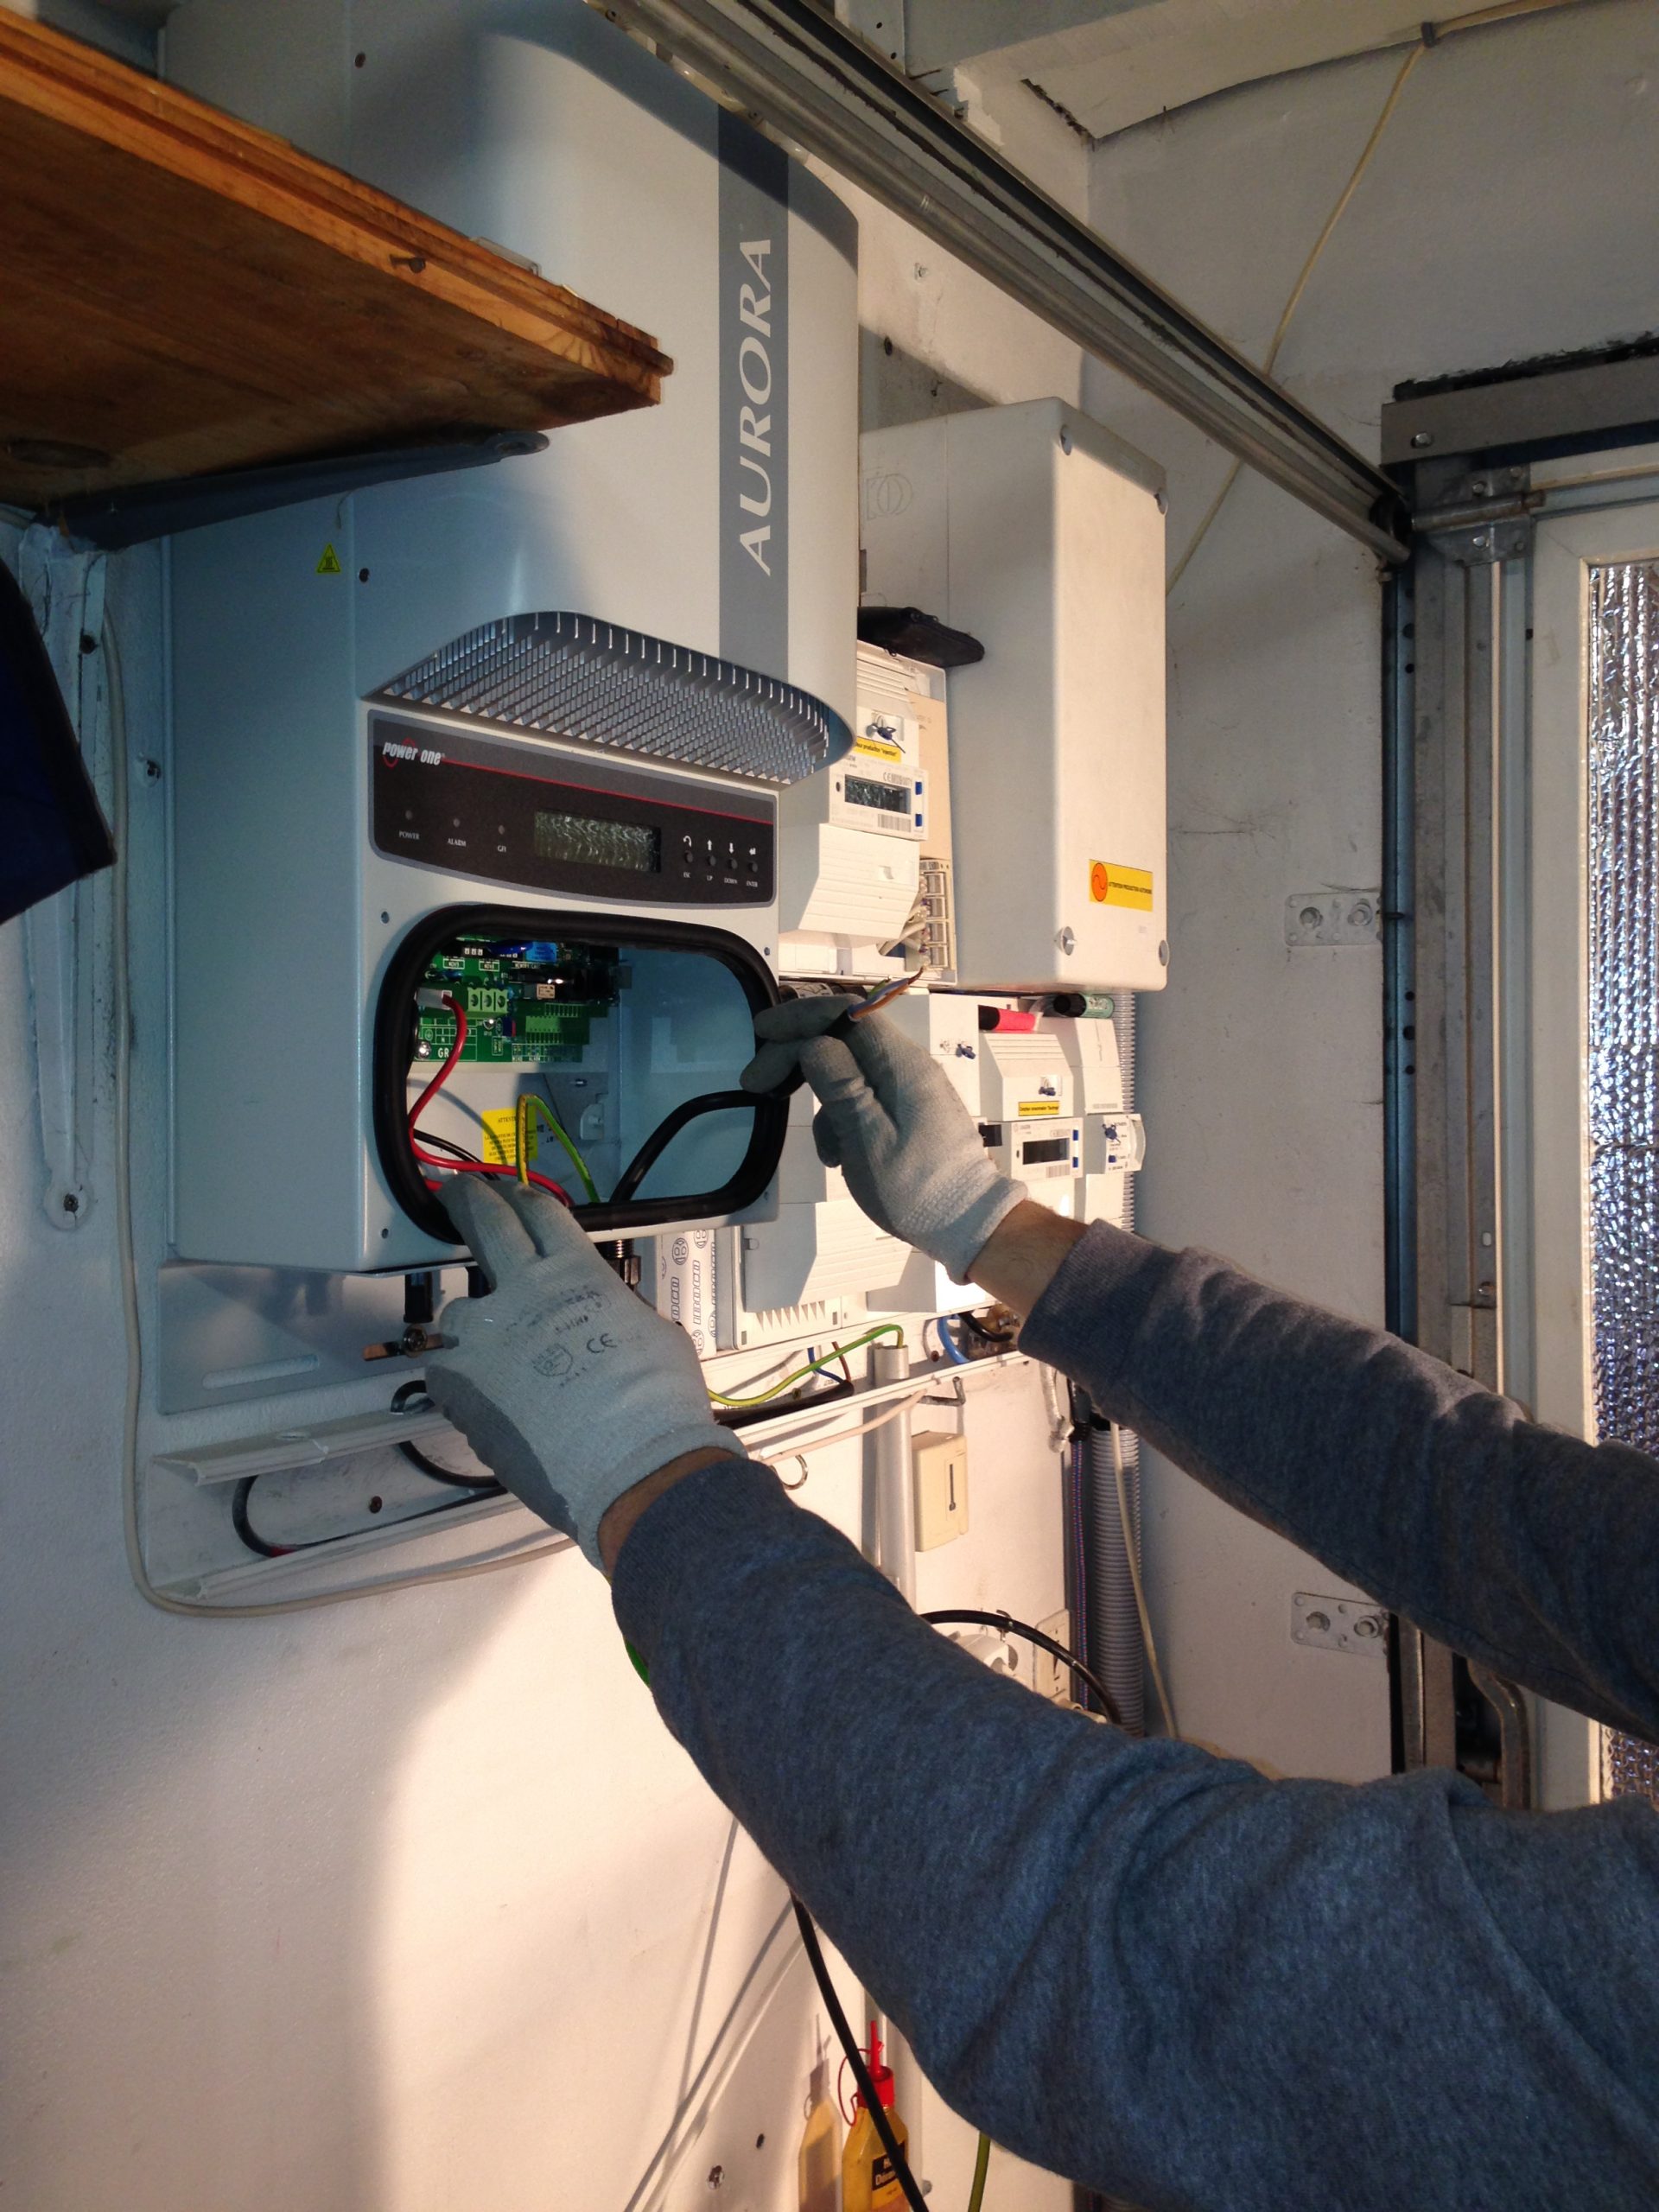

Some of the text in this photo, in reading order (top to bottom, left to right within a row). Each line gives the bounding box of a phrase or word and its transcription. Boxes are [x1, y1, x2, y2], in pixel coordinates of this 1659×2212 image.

[739, 238, 772, 577] AURORA
[420, 749, 442, 766] one
[398, 830, 420, 840] POWER
[448, 838, 467, 847] ALARM
